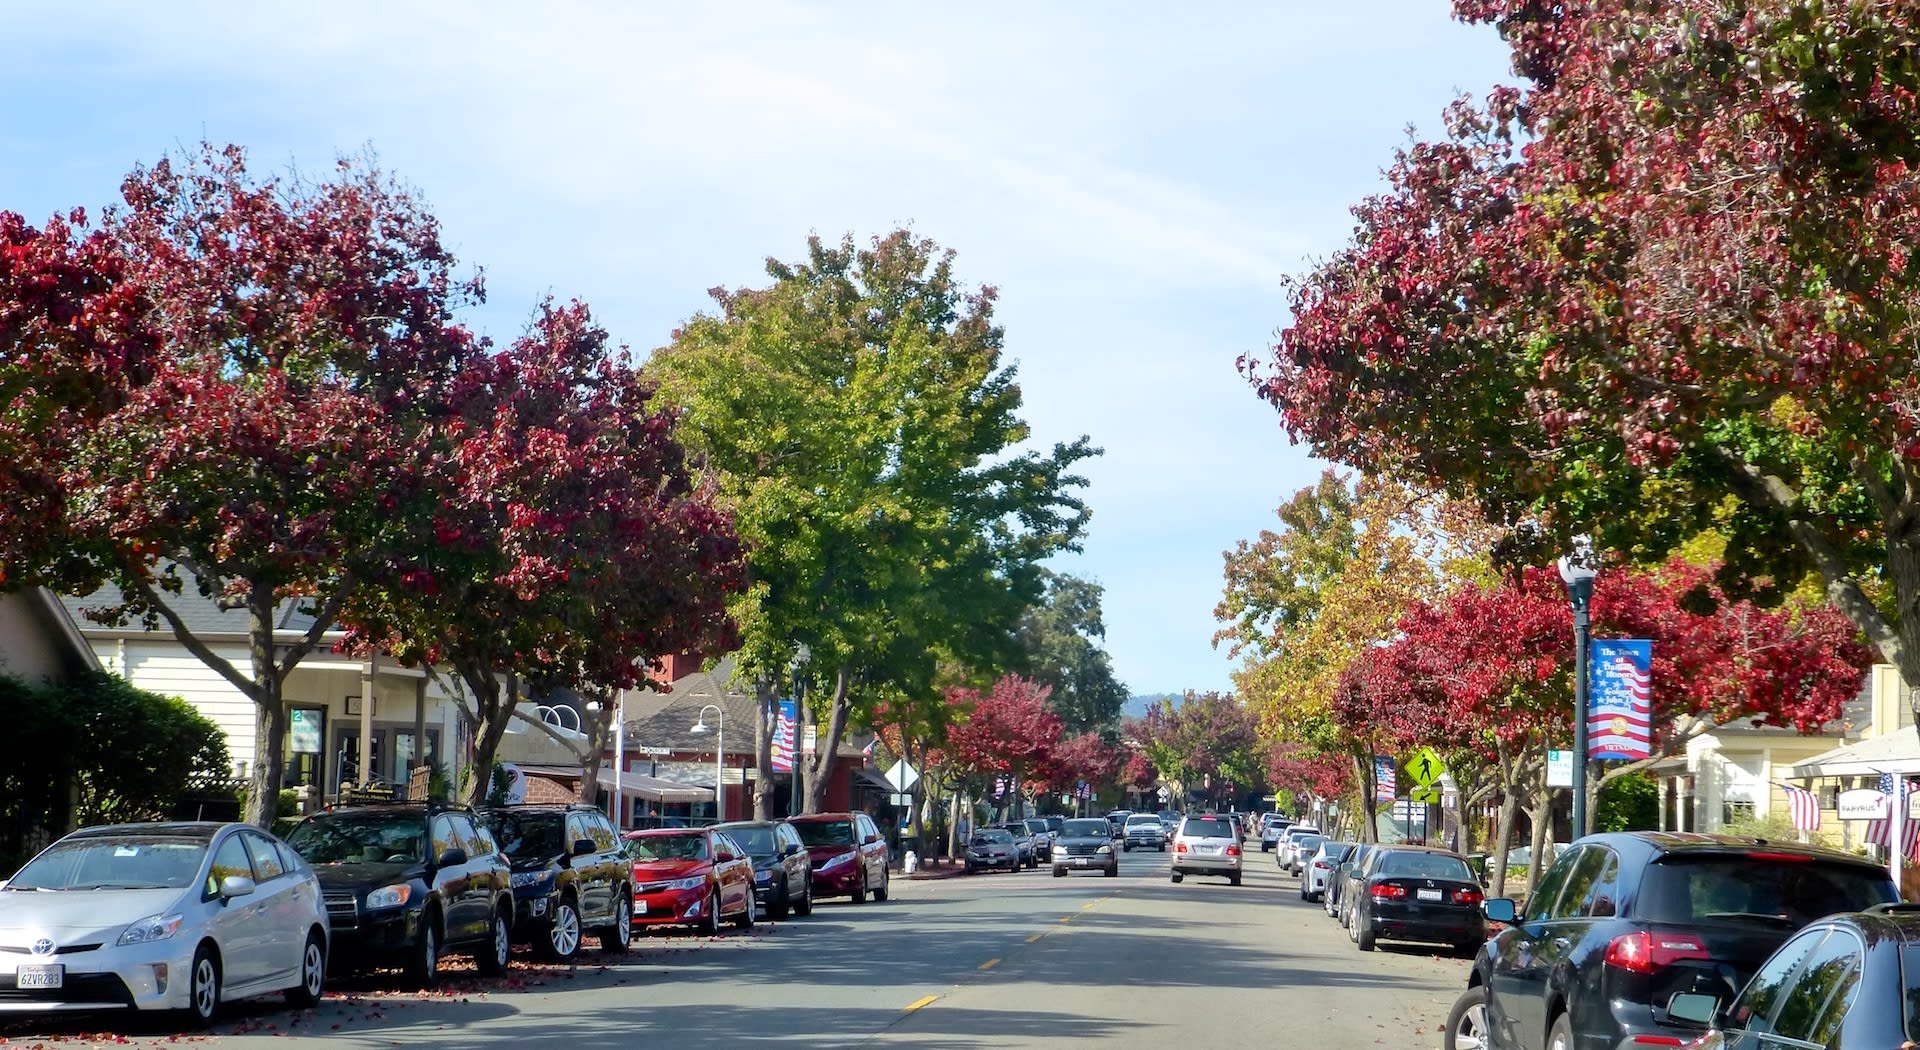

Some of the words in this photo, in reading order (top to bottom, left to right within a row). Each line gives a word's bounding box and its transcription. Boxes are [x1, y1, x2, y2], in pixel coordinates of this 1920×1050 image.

[1601, 648, 1616, 656] The
[1617, 648, 1639, 656] Town
[294, 710, 303, 720] 2
[1551, 751, 1559, 760] 2
[21, 973, 60, 985] 6ZVR283
